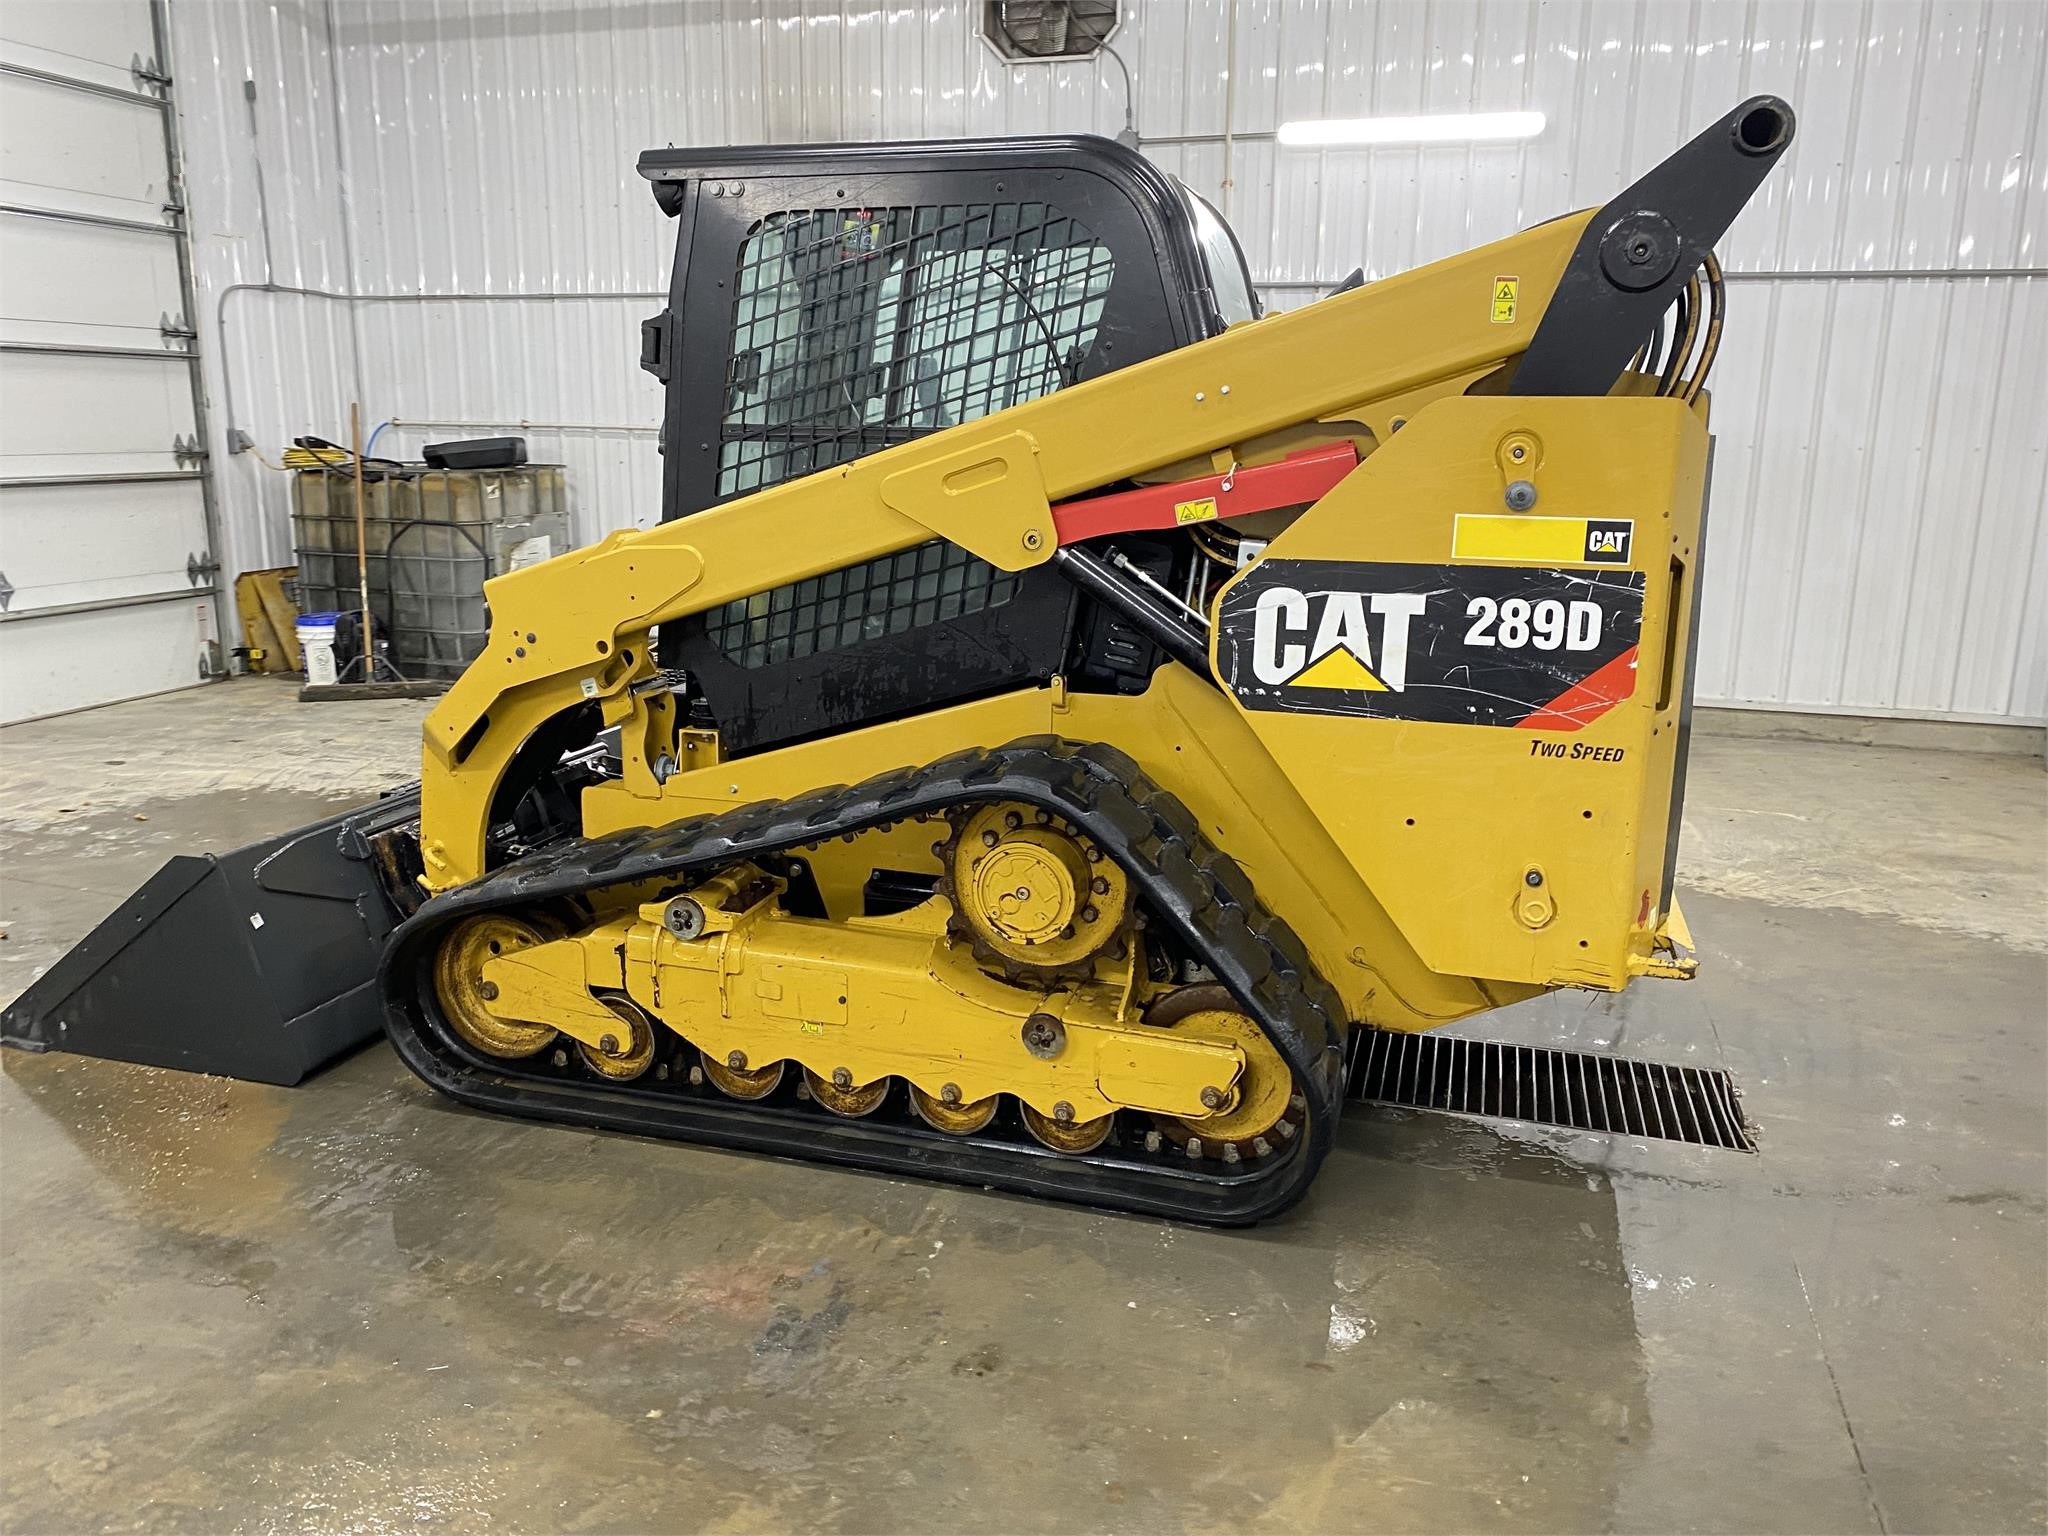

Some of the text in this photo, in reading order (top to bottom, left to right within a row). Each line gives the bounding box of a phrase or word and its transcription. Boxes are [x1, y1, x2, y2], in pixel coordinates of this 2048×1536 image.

[1589, 530, 1627, 553] CAT
[1253, 587, 1603, 693] CAT 289D
